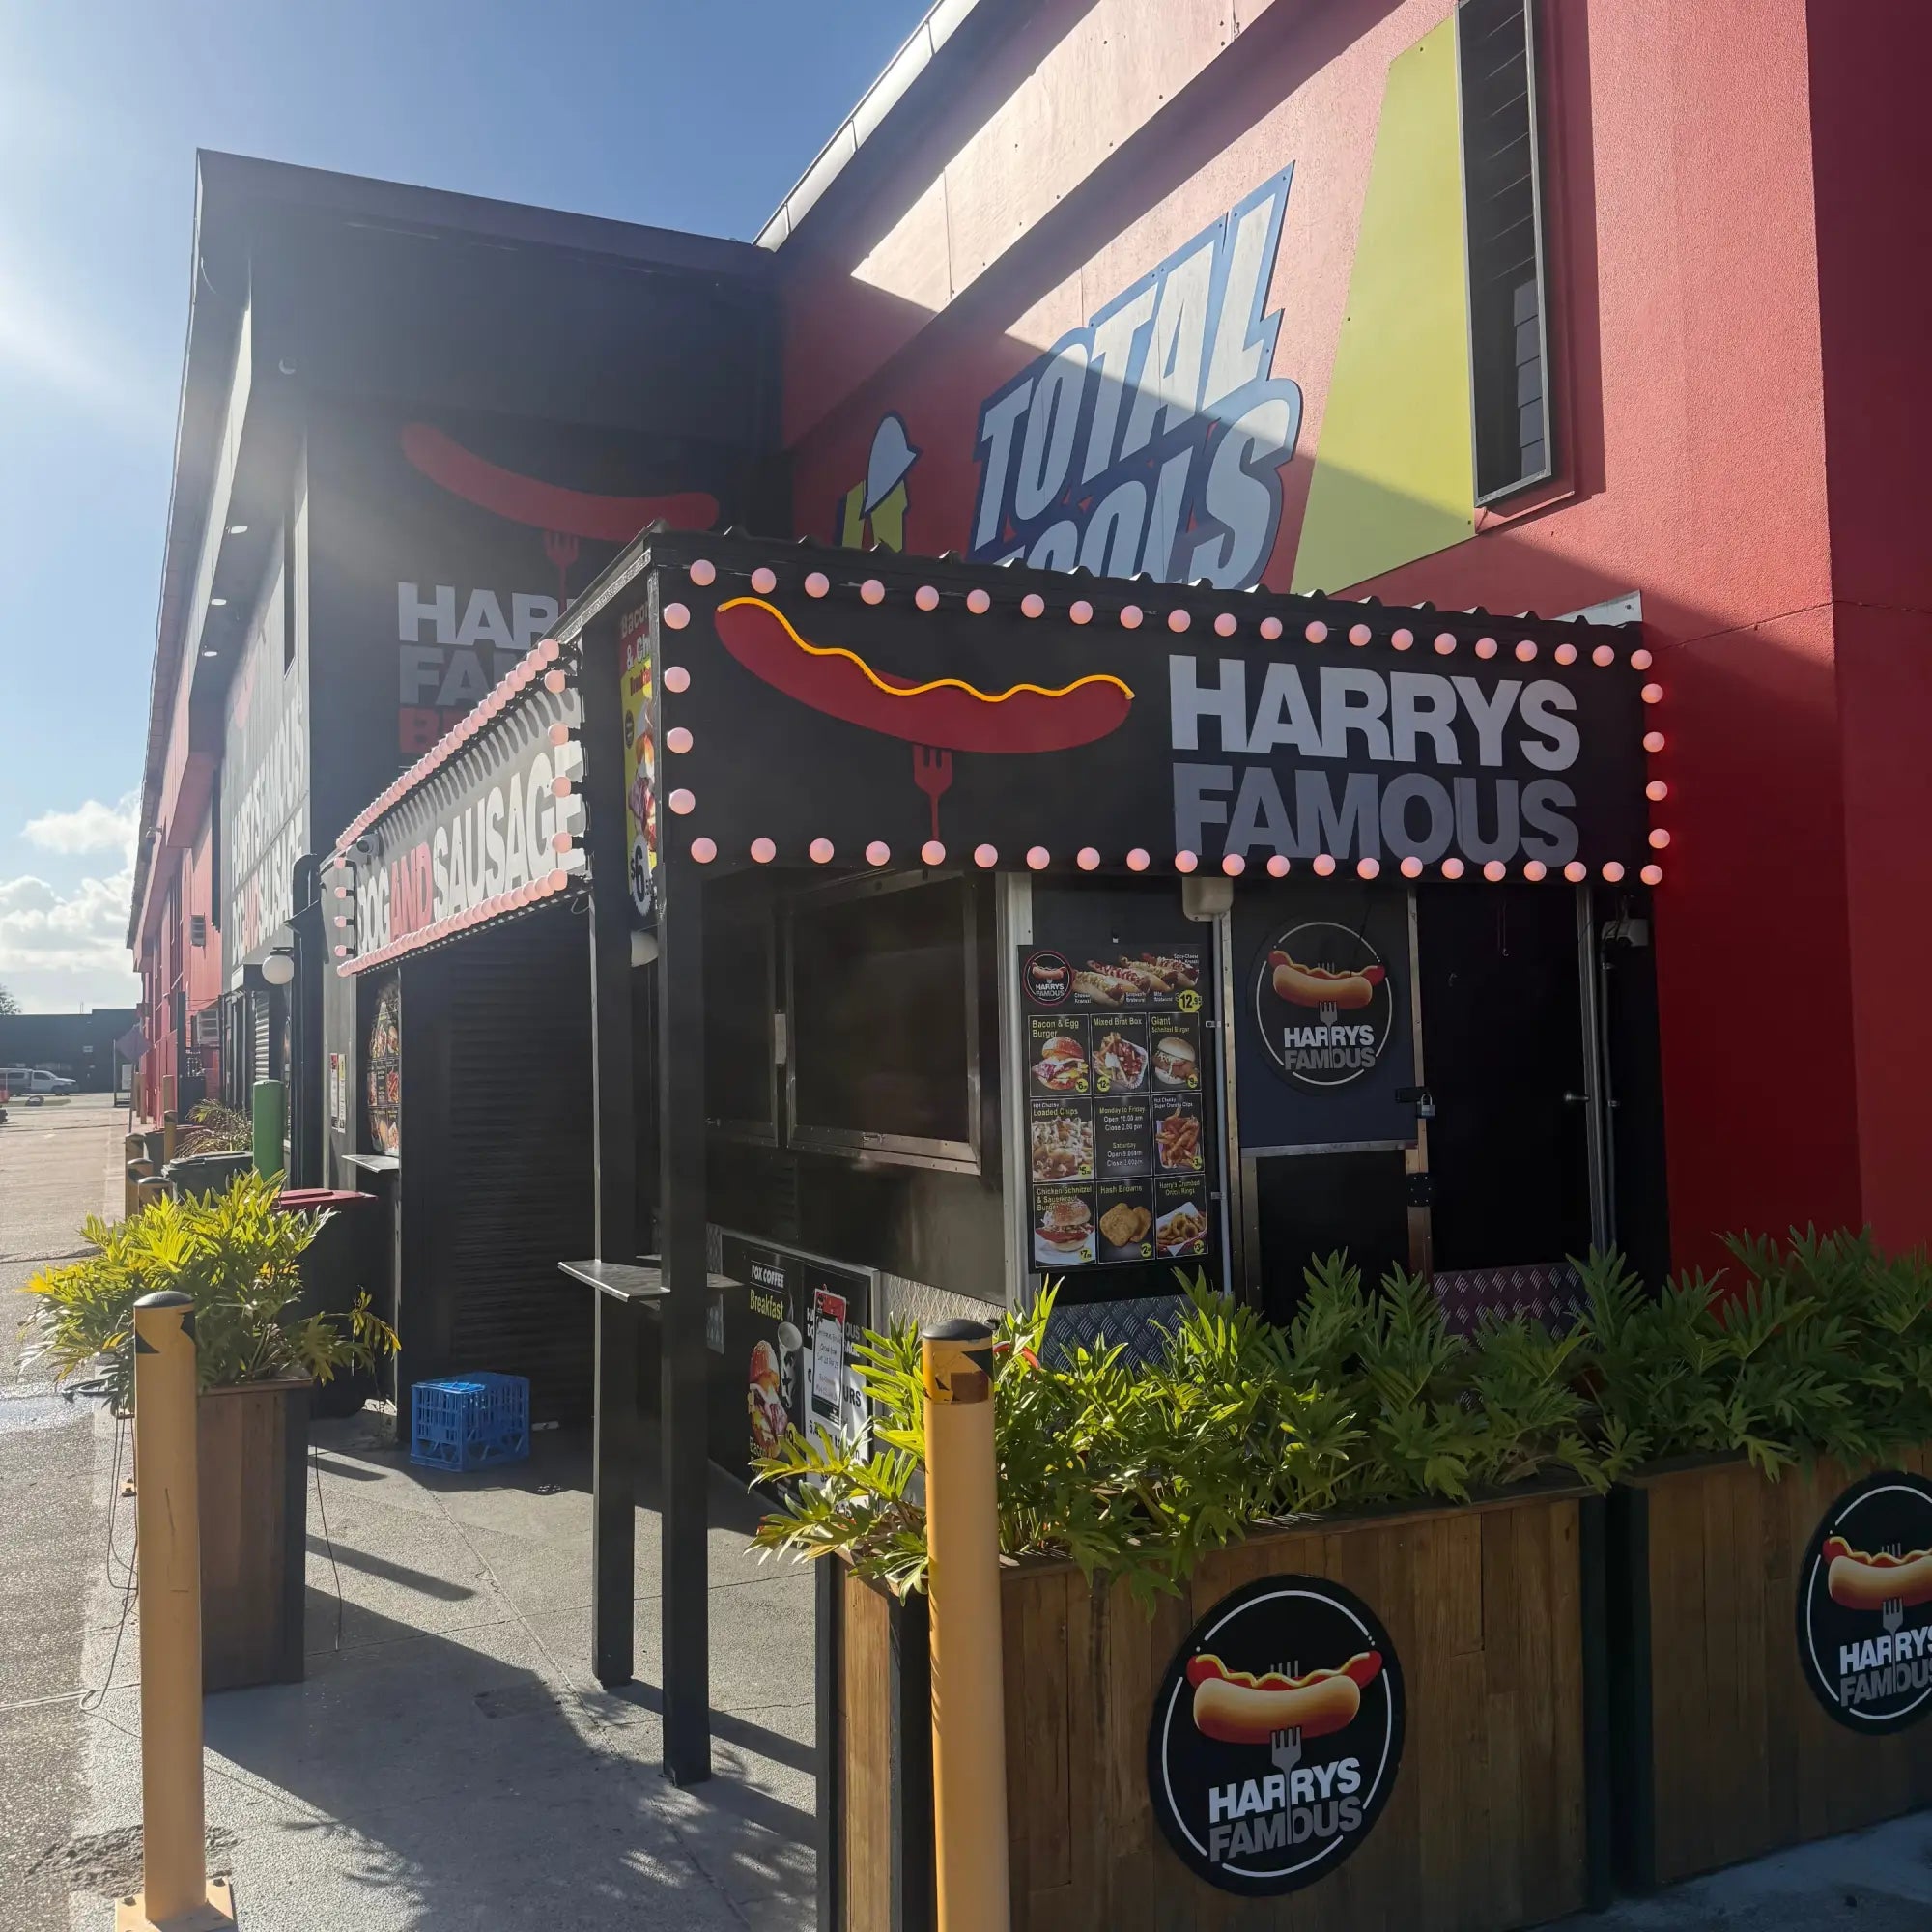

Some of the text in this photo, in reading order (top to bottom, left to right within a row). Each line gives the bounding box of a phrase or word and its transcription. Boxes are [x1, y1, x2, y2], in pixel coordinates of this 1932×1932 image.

[972, 191, 1278, 553] TOTAL
[398, 582, 575, 651] HAR
[1169, 654, 1580, 771] HARRYS
[1173, 762, 1580, 867] FAMOUS
[390, 841, 433, 942] AND
[433, 741, 586, 924] SAUSAGE
[1032, 1020, 1055, 1029] Bacon
[1065, 1019, 1079, 1030] Egg
[1094, 1016, 1143, 1026] Mixed Brat Box
[1151, 1015, 1171, 1025] Giant
[1032, 1029, 1058, 1038] Burger
[1284, 1024, 1375, 1048] HARRYS
[1284, 1047, 1376, 1070] FAMOUS
[1033, 1107, 1079, 1117] Loaded Chips
[1099, 1106, 1121, 1116] Monday
[1128, 1105, 1146, 1114] Friday
[1064, 1185, 1093, 1195] Schnitzel
[1100, 1184, 1143, 1194] Hash Browns
[1181, 1187, 1196, 1196] Rings
[1037, 1204, 1057, 1212] Burg
[763, 1268, 785, 1289] COFFEE
[750, 1289, 784, 1321] Breakfast
[843, 1385, 862, 1408] URS
[1839, 1624, 1932, 1675] HARRY
[1839, 1656, 1932, 1708] FAMOU
[1208, 1757, 1361, 1823] HARRYS
[1209, 1795, 1363, 1862] FAMOUS
